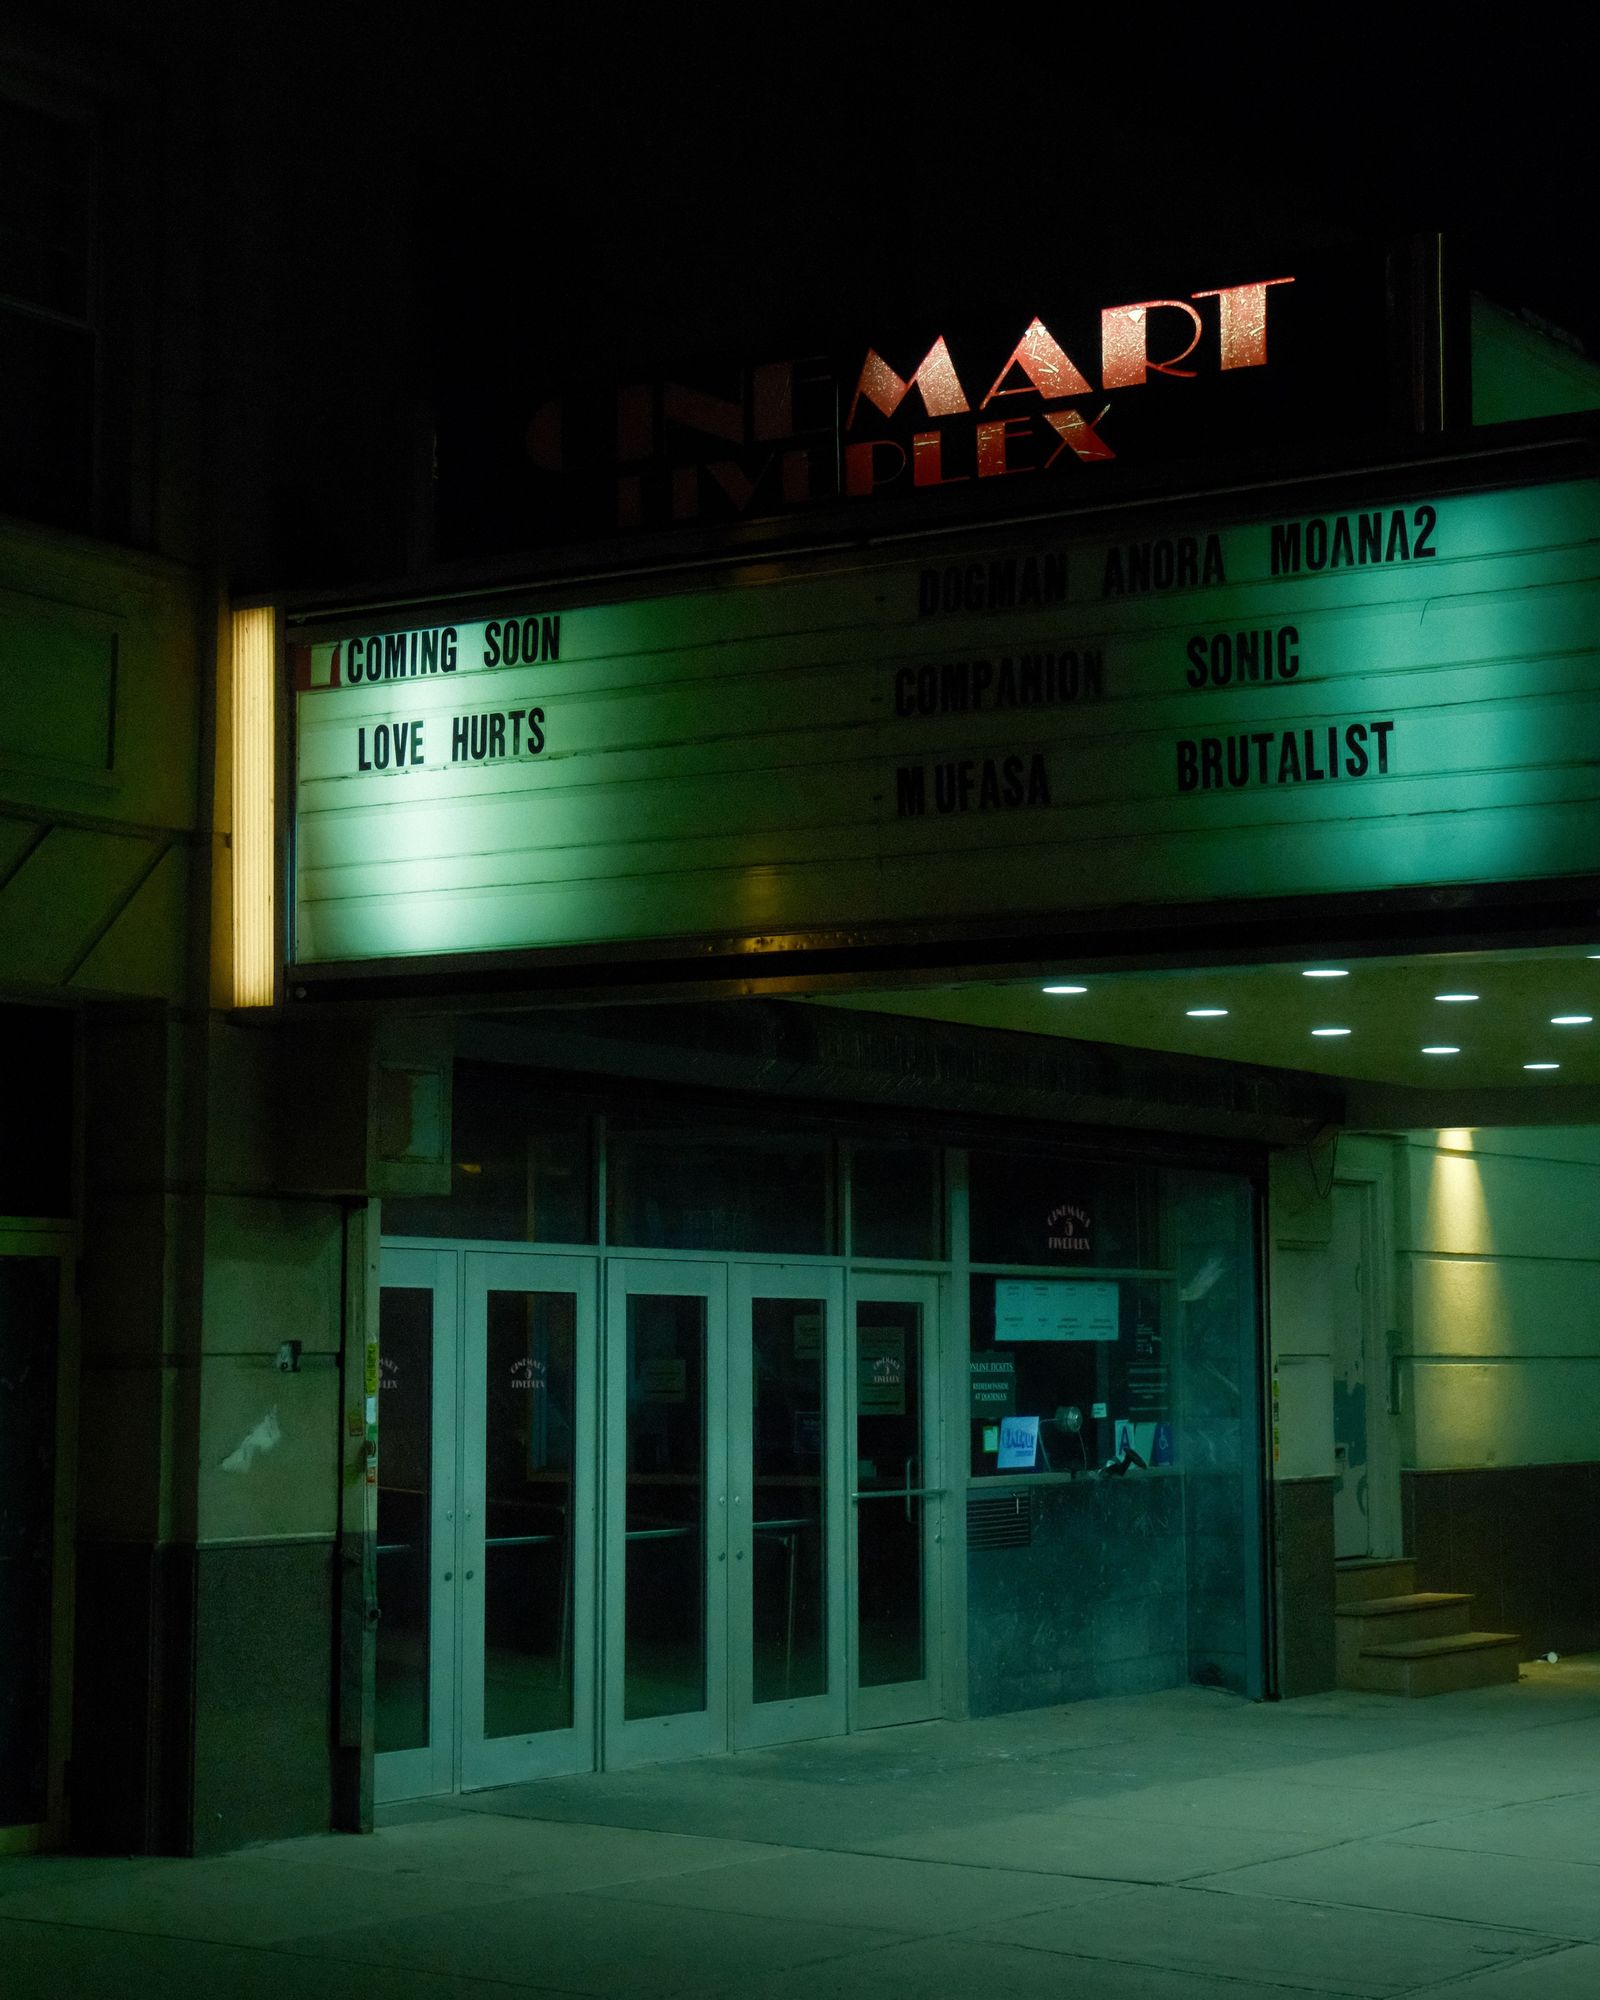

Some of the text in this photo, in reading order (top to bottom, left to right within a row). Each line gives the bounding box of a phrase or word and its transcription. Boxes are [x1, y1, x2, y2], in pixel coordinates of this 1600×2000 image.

[526, 276, 1296, 474] CINEMART
[919, 505, 1436, 615] DOGMAN ANORA MOANA2
[348, 616, 560, 683] COMING SOON
[895, 626, 1299, 717] COMPANION SONIC
[358, 708, 545, 771] LOVE HURTS
[897, 721, 1393, 816] MUFASA BRUTALIST
